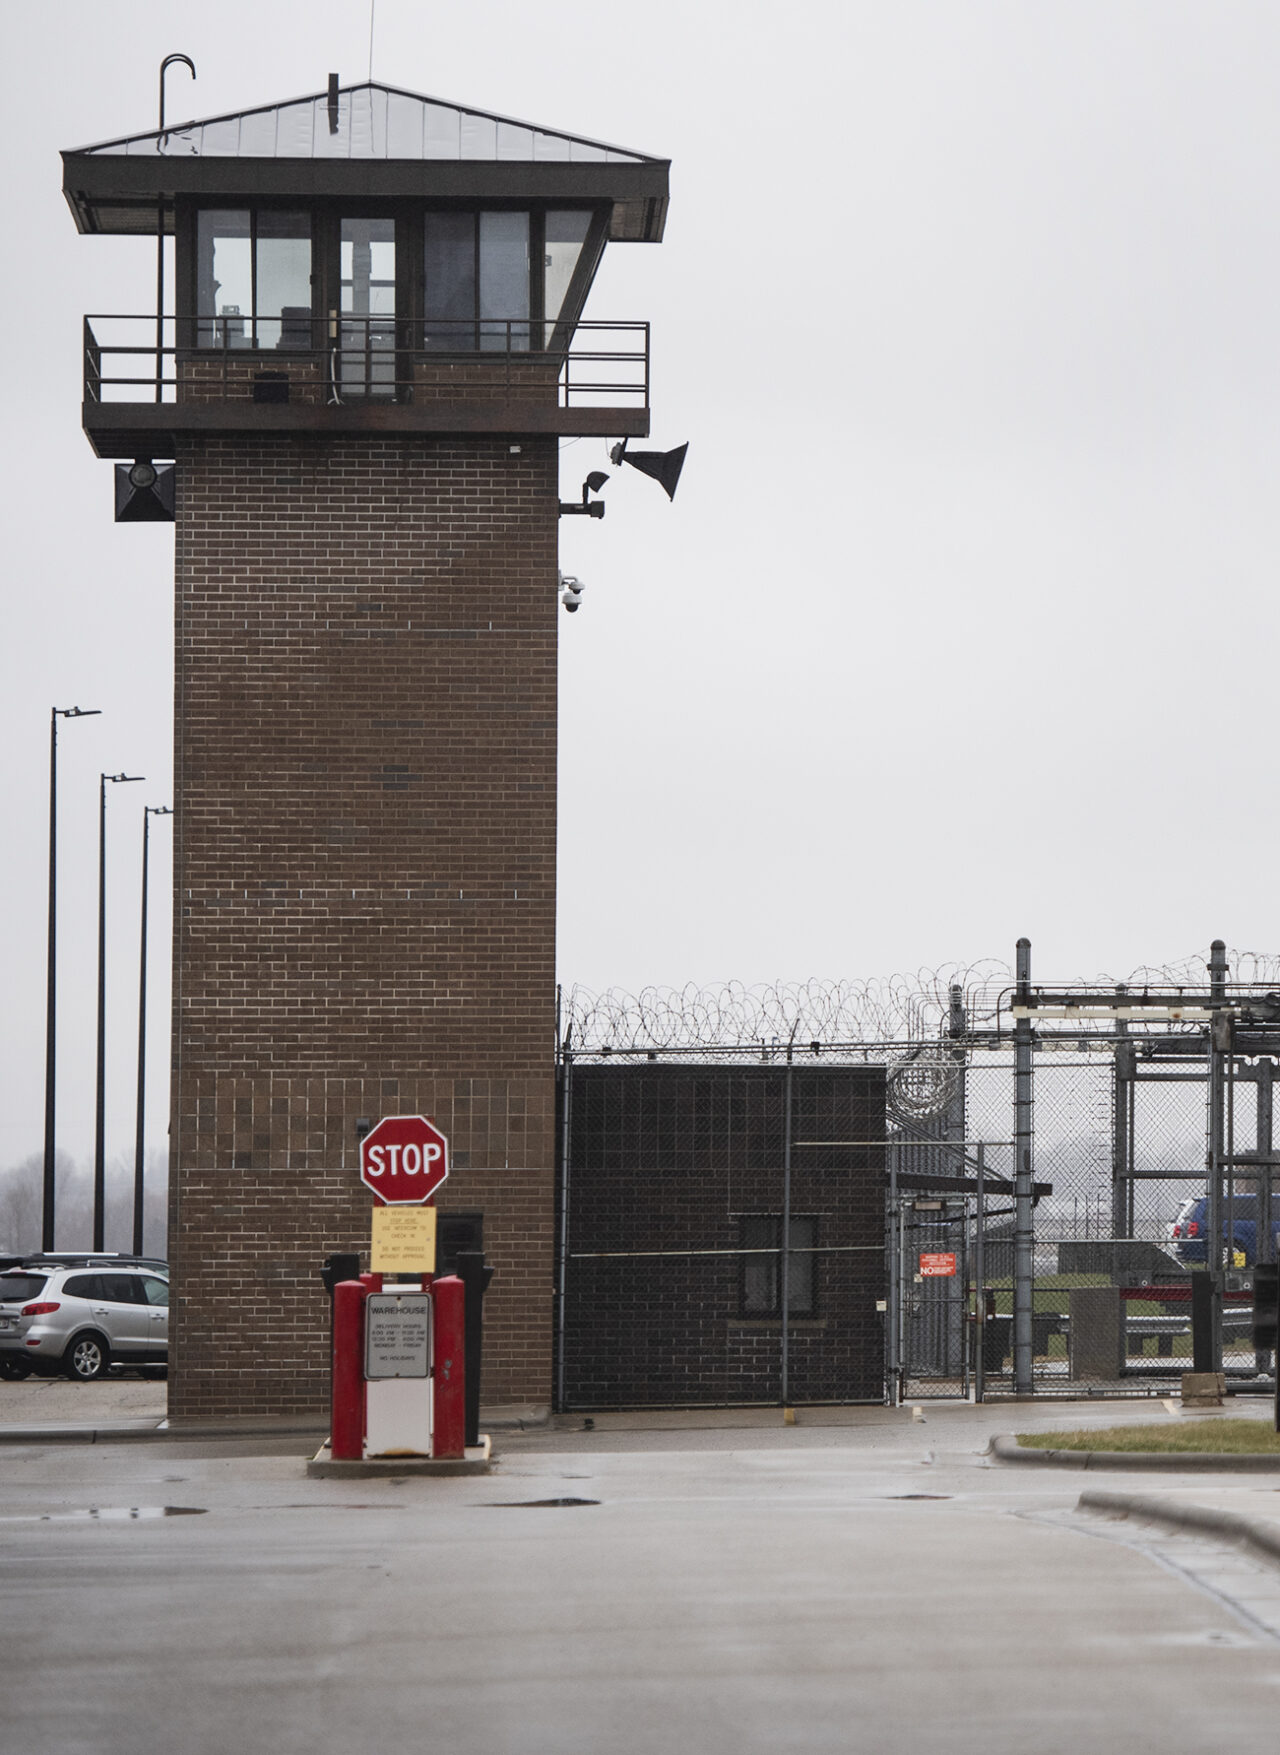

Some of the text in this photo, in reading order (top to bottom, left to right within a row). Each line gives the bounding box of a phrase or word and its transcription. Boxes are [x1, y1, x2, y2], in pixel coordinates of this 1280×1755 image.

[367, 1143, 441, 1177] STOP
[920, 1266, 934, 1275] NO
[371, 1306, 426, 1314] WAREHOUSE
